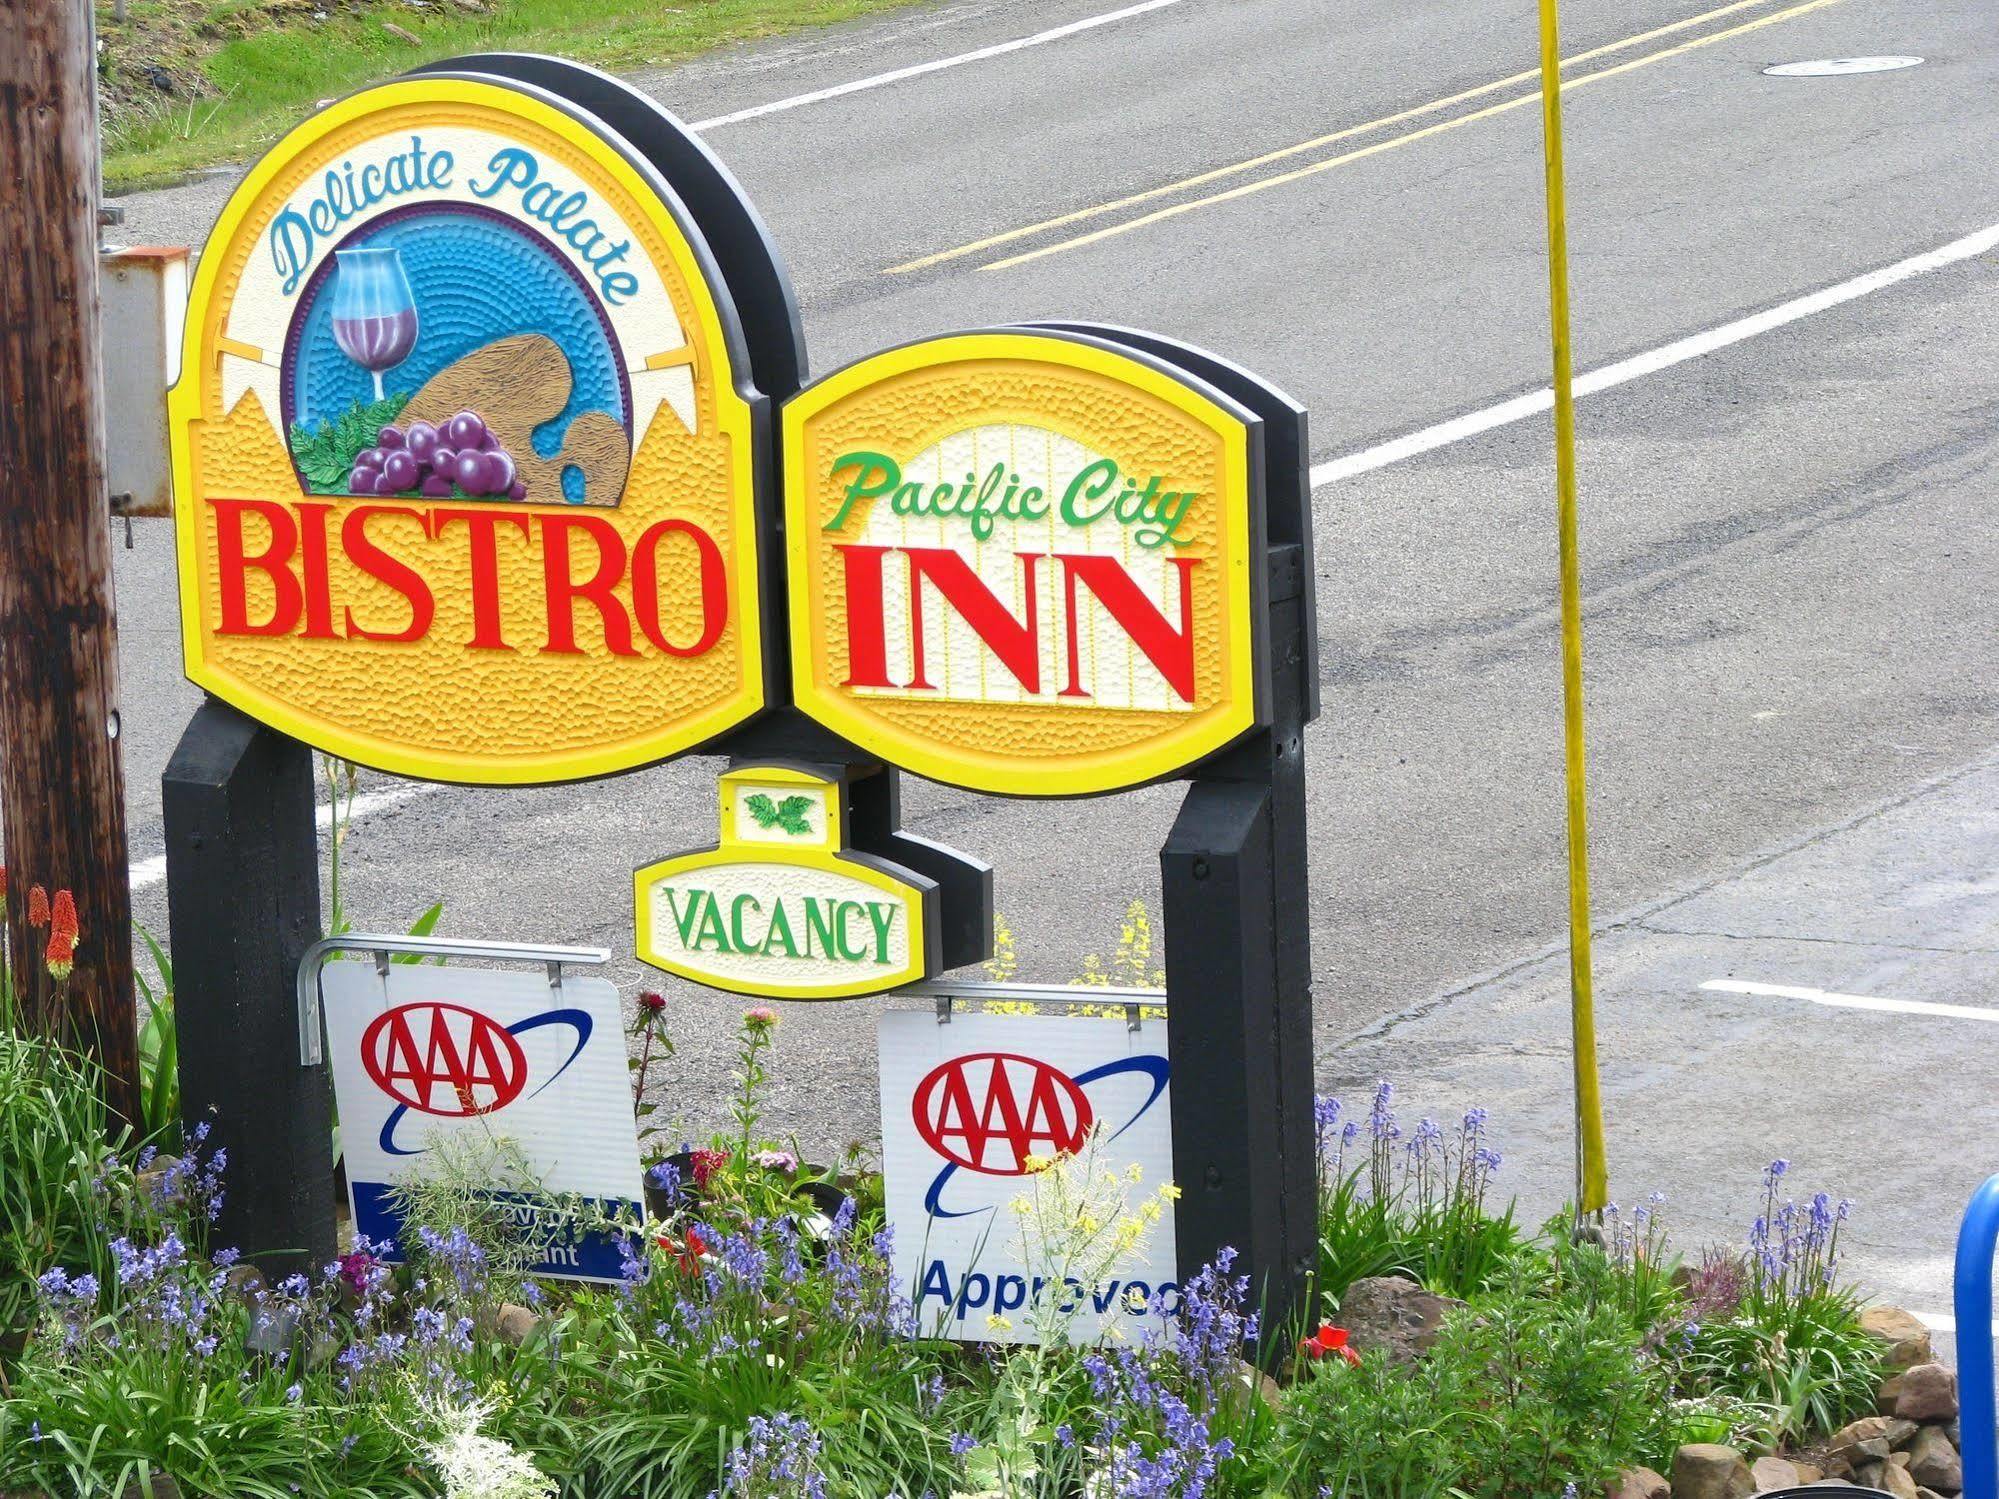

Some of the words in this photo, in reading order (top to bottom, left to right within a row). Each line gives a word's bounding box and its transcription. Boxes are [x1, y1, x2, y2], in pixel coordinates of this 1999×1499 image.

[270, 135, 454, 296] Delicate
[468, 147, 639, 306] Palate
[822, 450, 1050, 541] Pacific
[1059, 458, 1199, 546] City
[206, 498, 729, 658] BISTRO
[833, 543, 1202, 703] INN
[661, 887, 901, 965] VACANCY
[378, 1004, 516, 1113] AAA
[930, 1056, 1080, 1171] AAA
